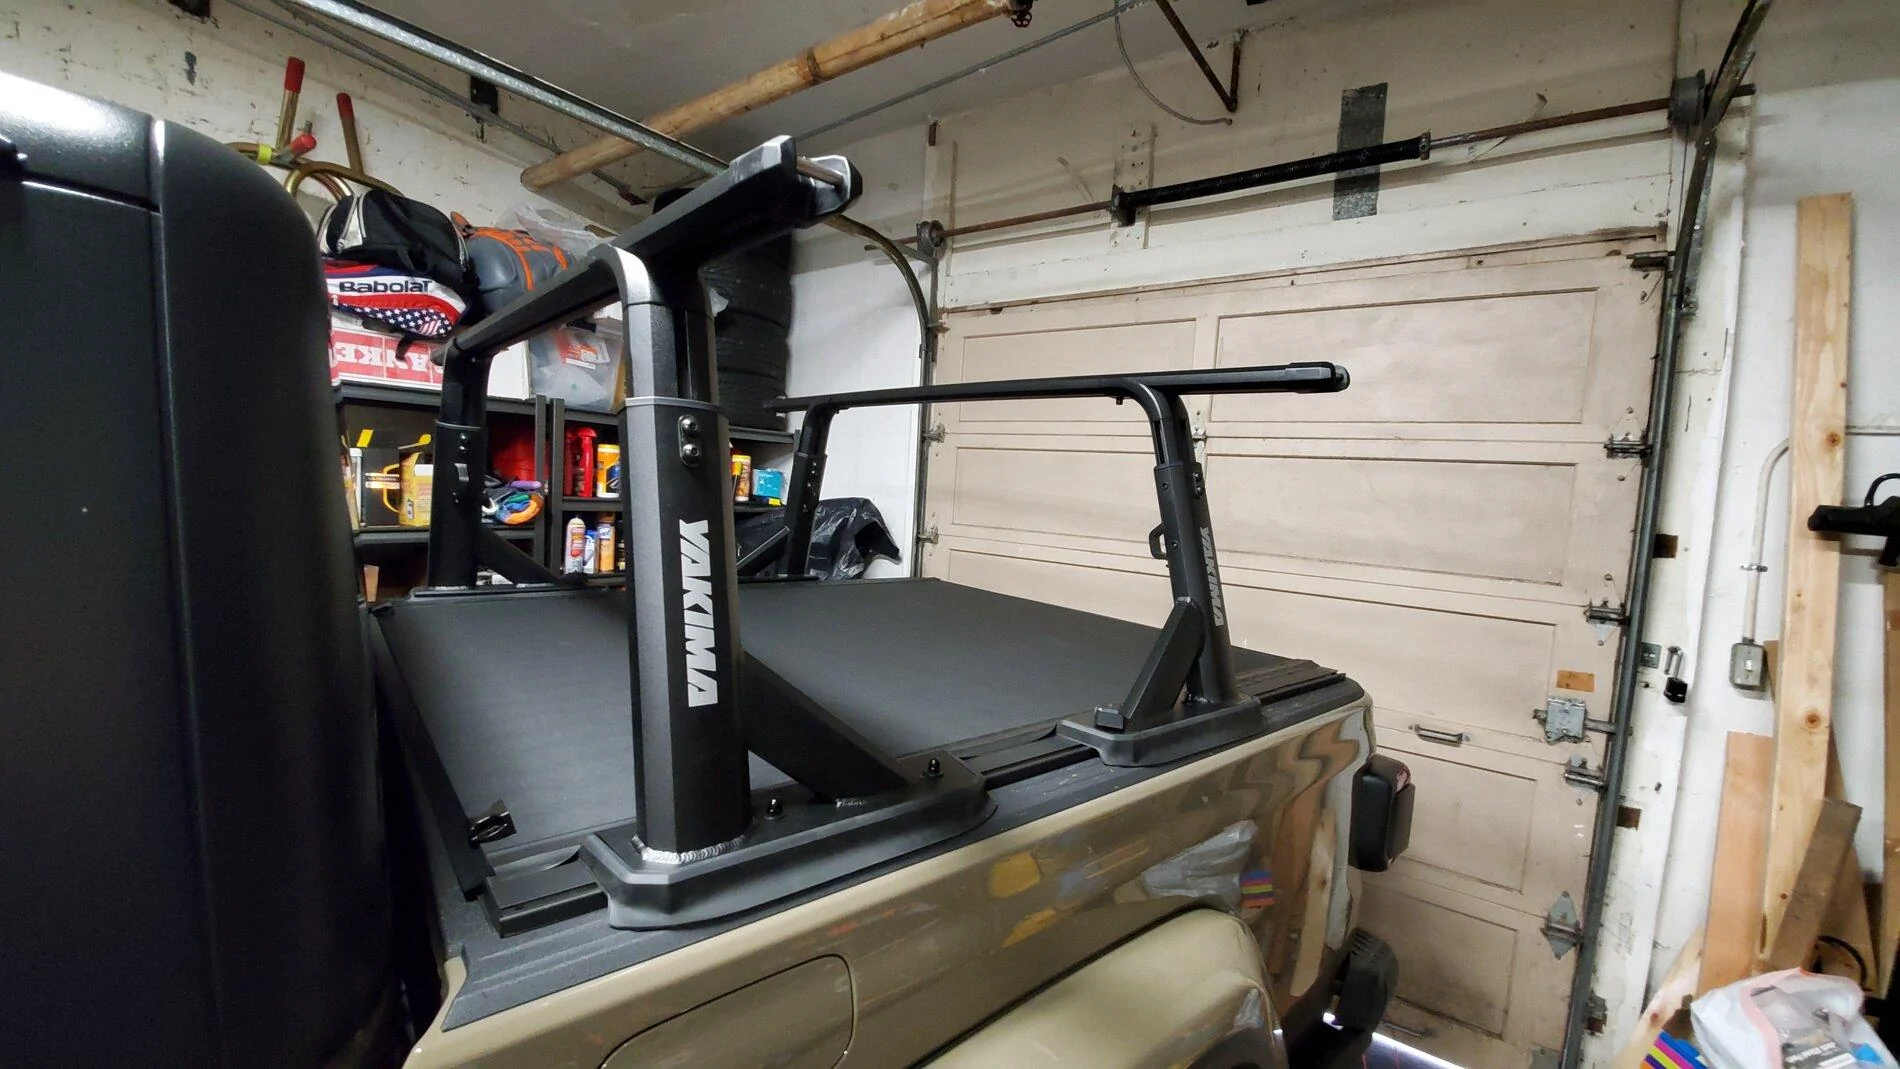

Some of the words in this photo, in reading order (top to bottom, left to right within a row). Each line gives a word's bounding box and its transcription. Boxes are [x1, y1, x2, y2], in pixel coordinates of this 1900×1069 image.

[331, 342, 443, 373] ANKE
[679, 518, 719, 708] YAKIMA
[1199, 526, 1225, 627] YAKIMA
